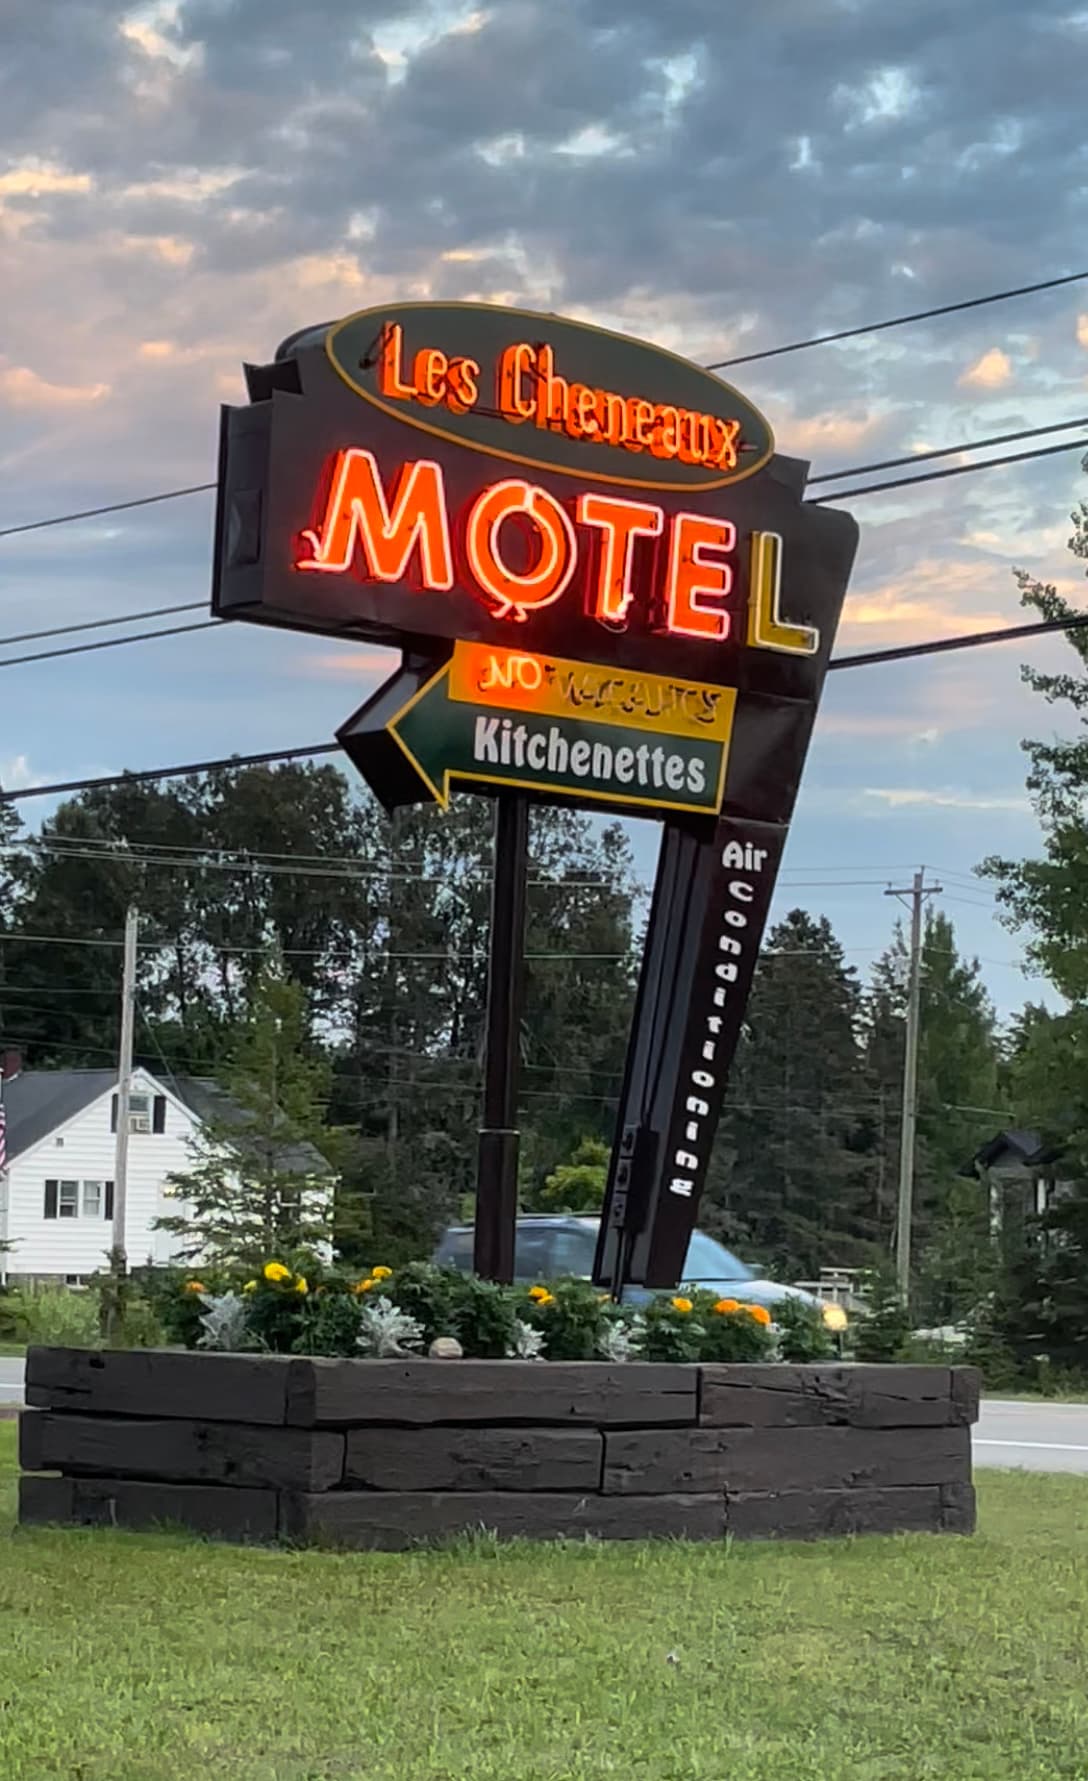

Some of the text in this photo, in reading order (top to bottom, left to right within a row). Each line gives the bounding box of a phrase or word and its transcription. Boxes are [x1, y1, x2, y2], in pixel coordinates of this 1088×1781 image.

[381, 321, 741, 470] Les Cheneaux
[296, 448, 819, 655] MOTEL
[484, 656, 543, 690] NO
[474, 715, 706, 793] Kitchenettes
[722, 841, 768, 872] Air
